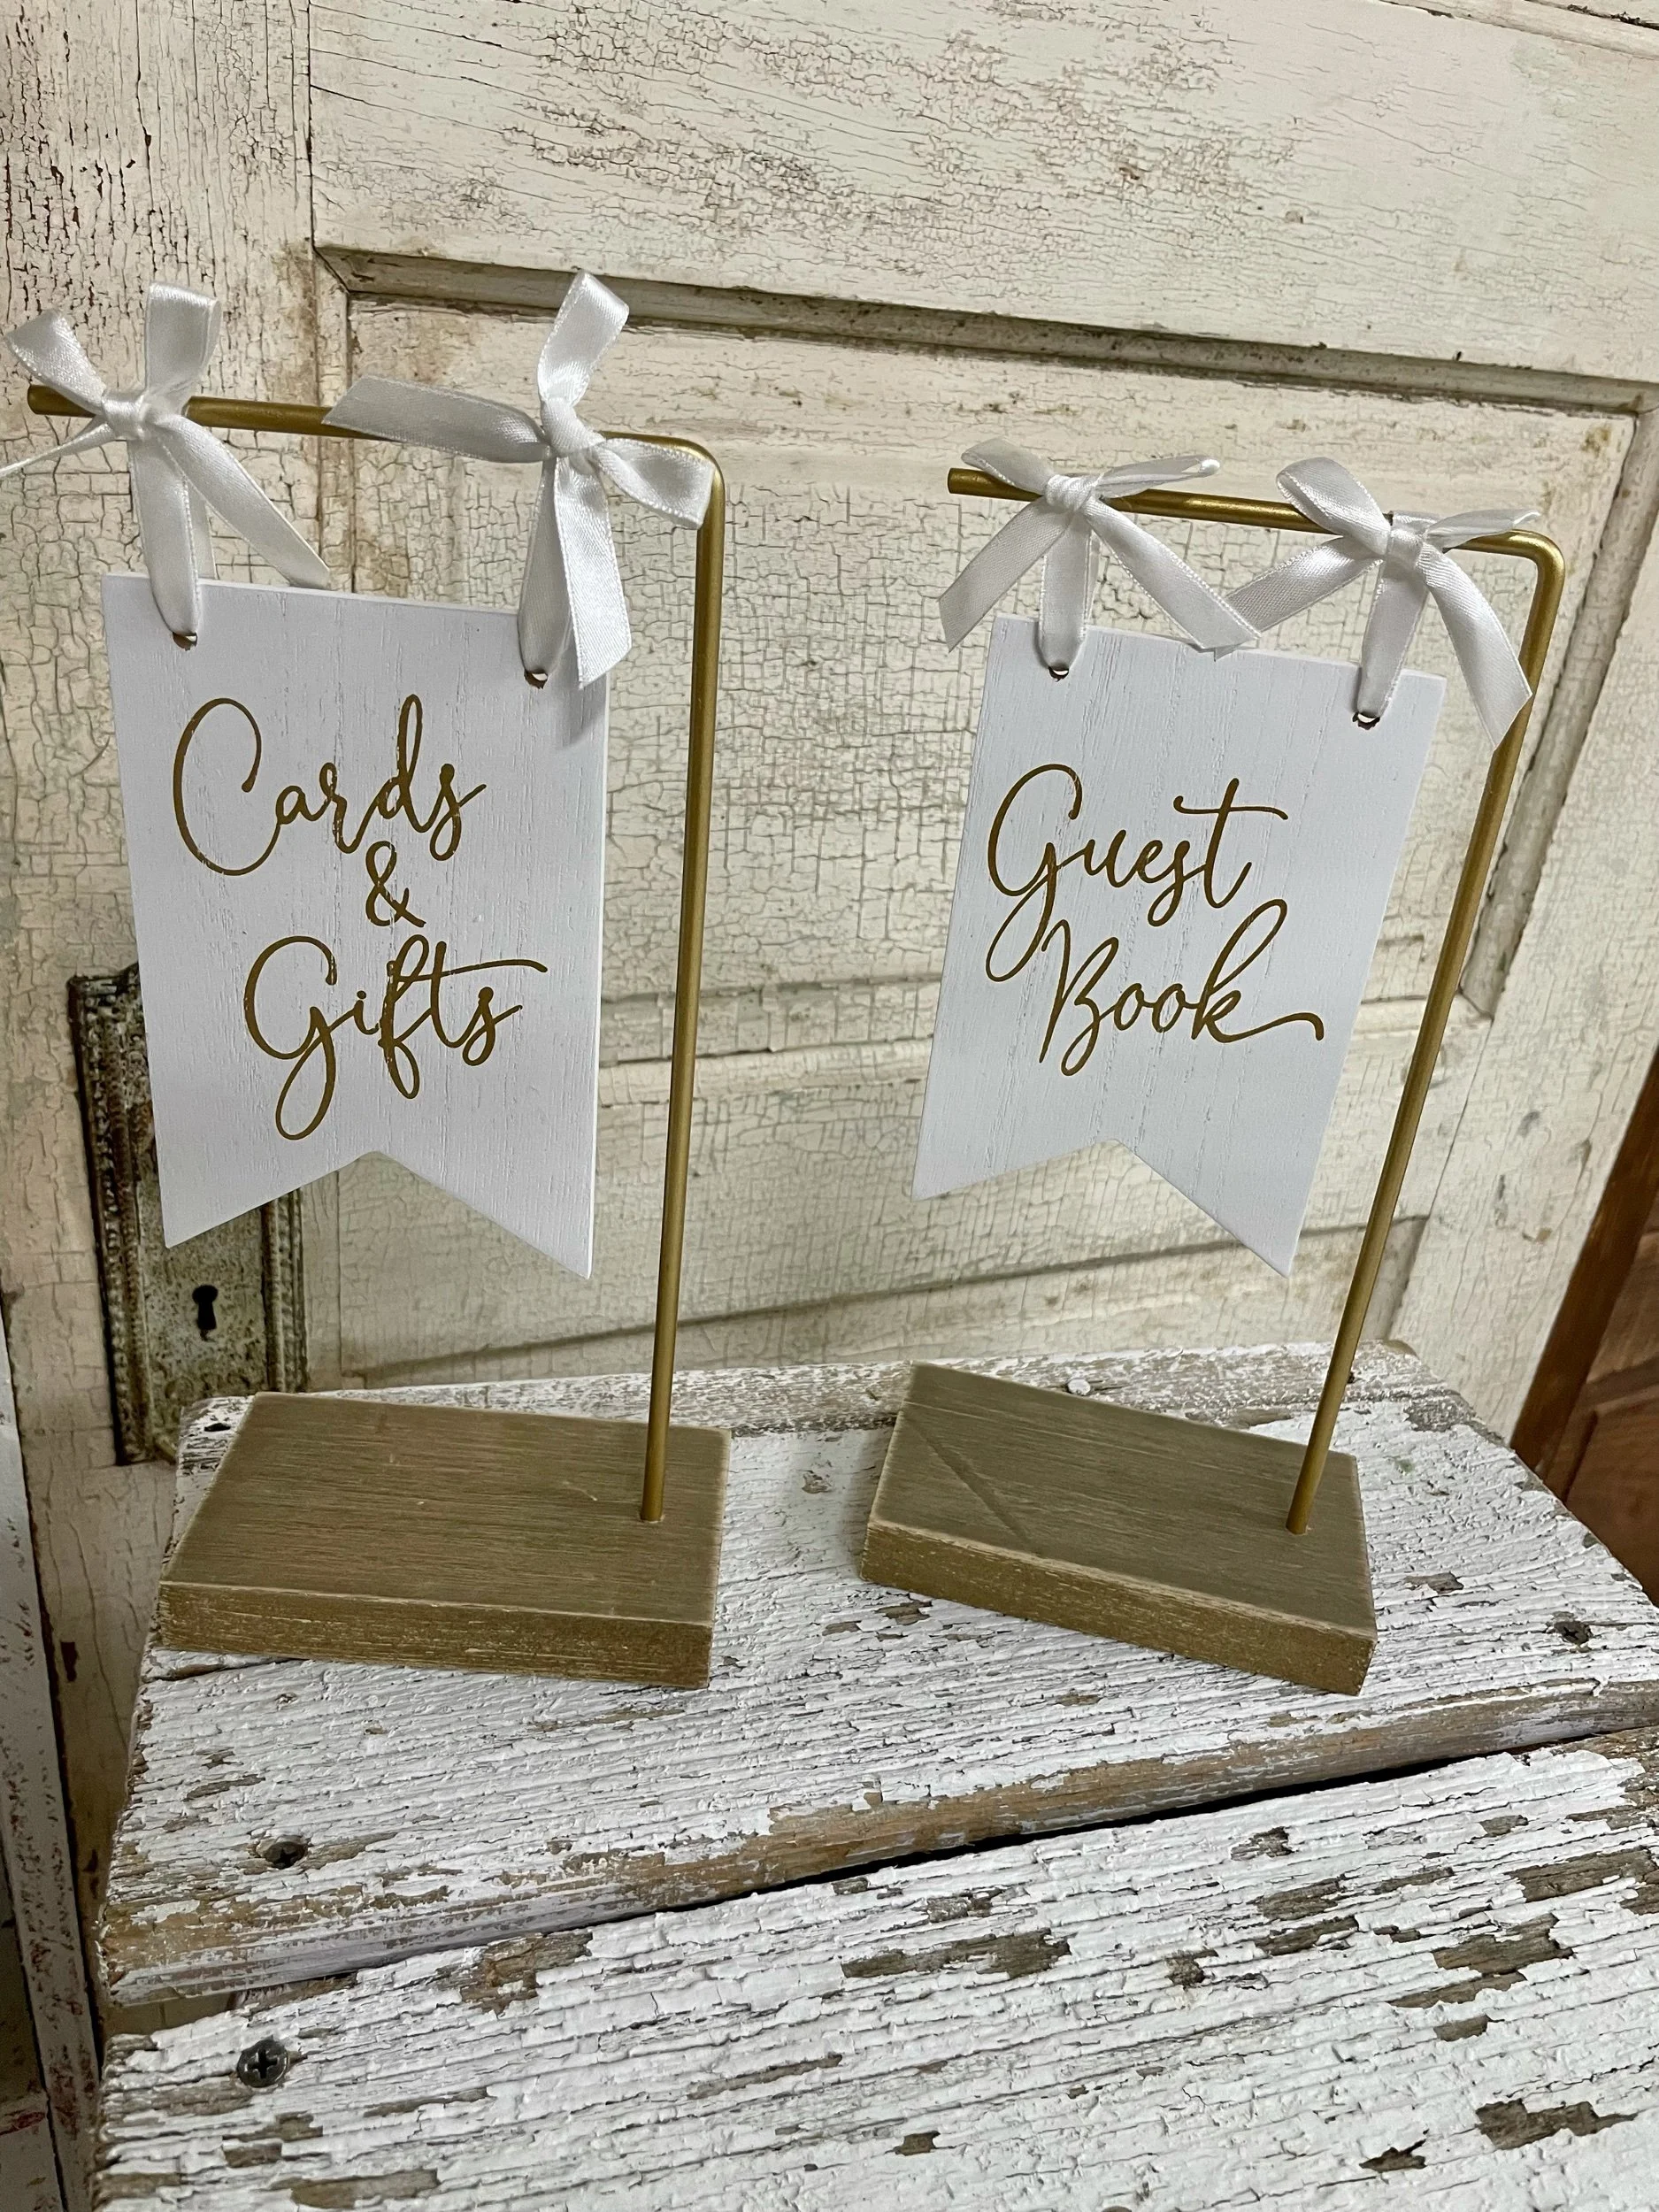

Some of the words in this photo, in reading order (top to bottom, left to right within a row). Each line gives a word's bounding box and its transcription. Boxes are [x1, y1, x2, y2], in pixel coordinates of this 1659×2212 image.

[173, 694, 487, 876] Cards
[985, 764, 1288, 982] Guest
[365, 841, 426, 928] &
[242, 933, 548, 1141] Gifts
[1039, 898, 1325, 1077] Book
